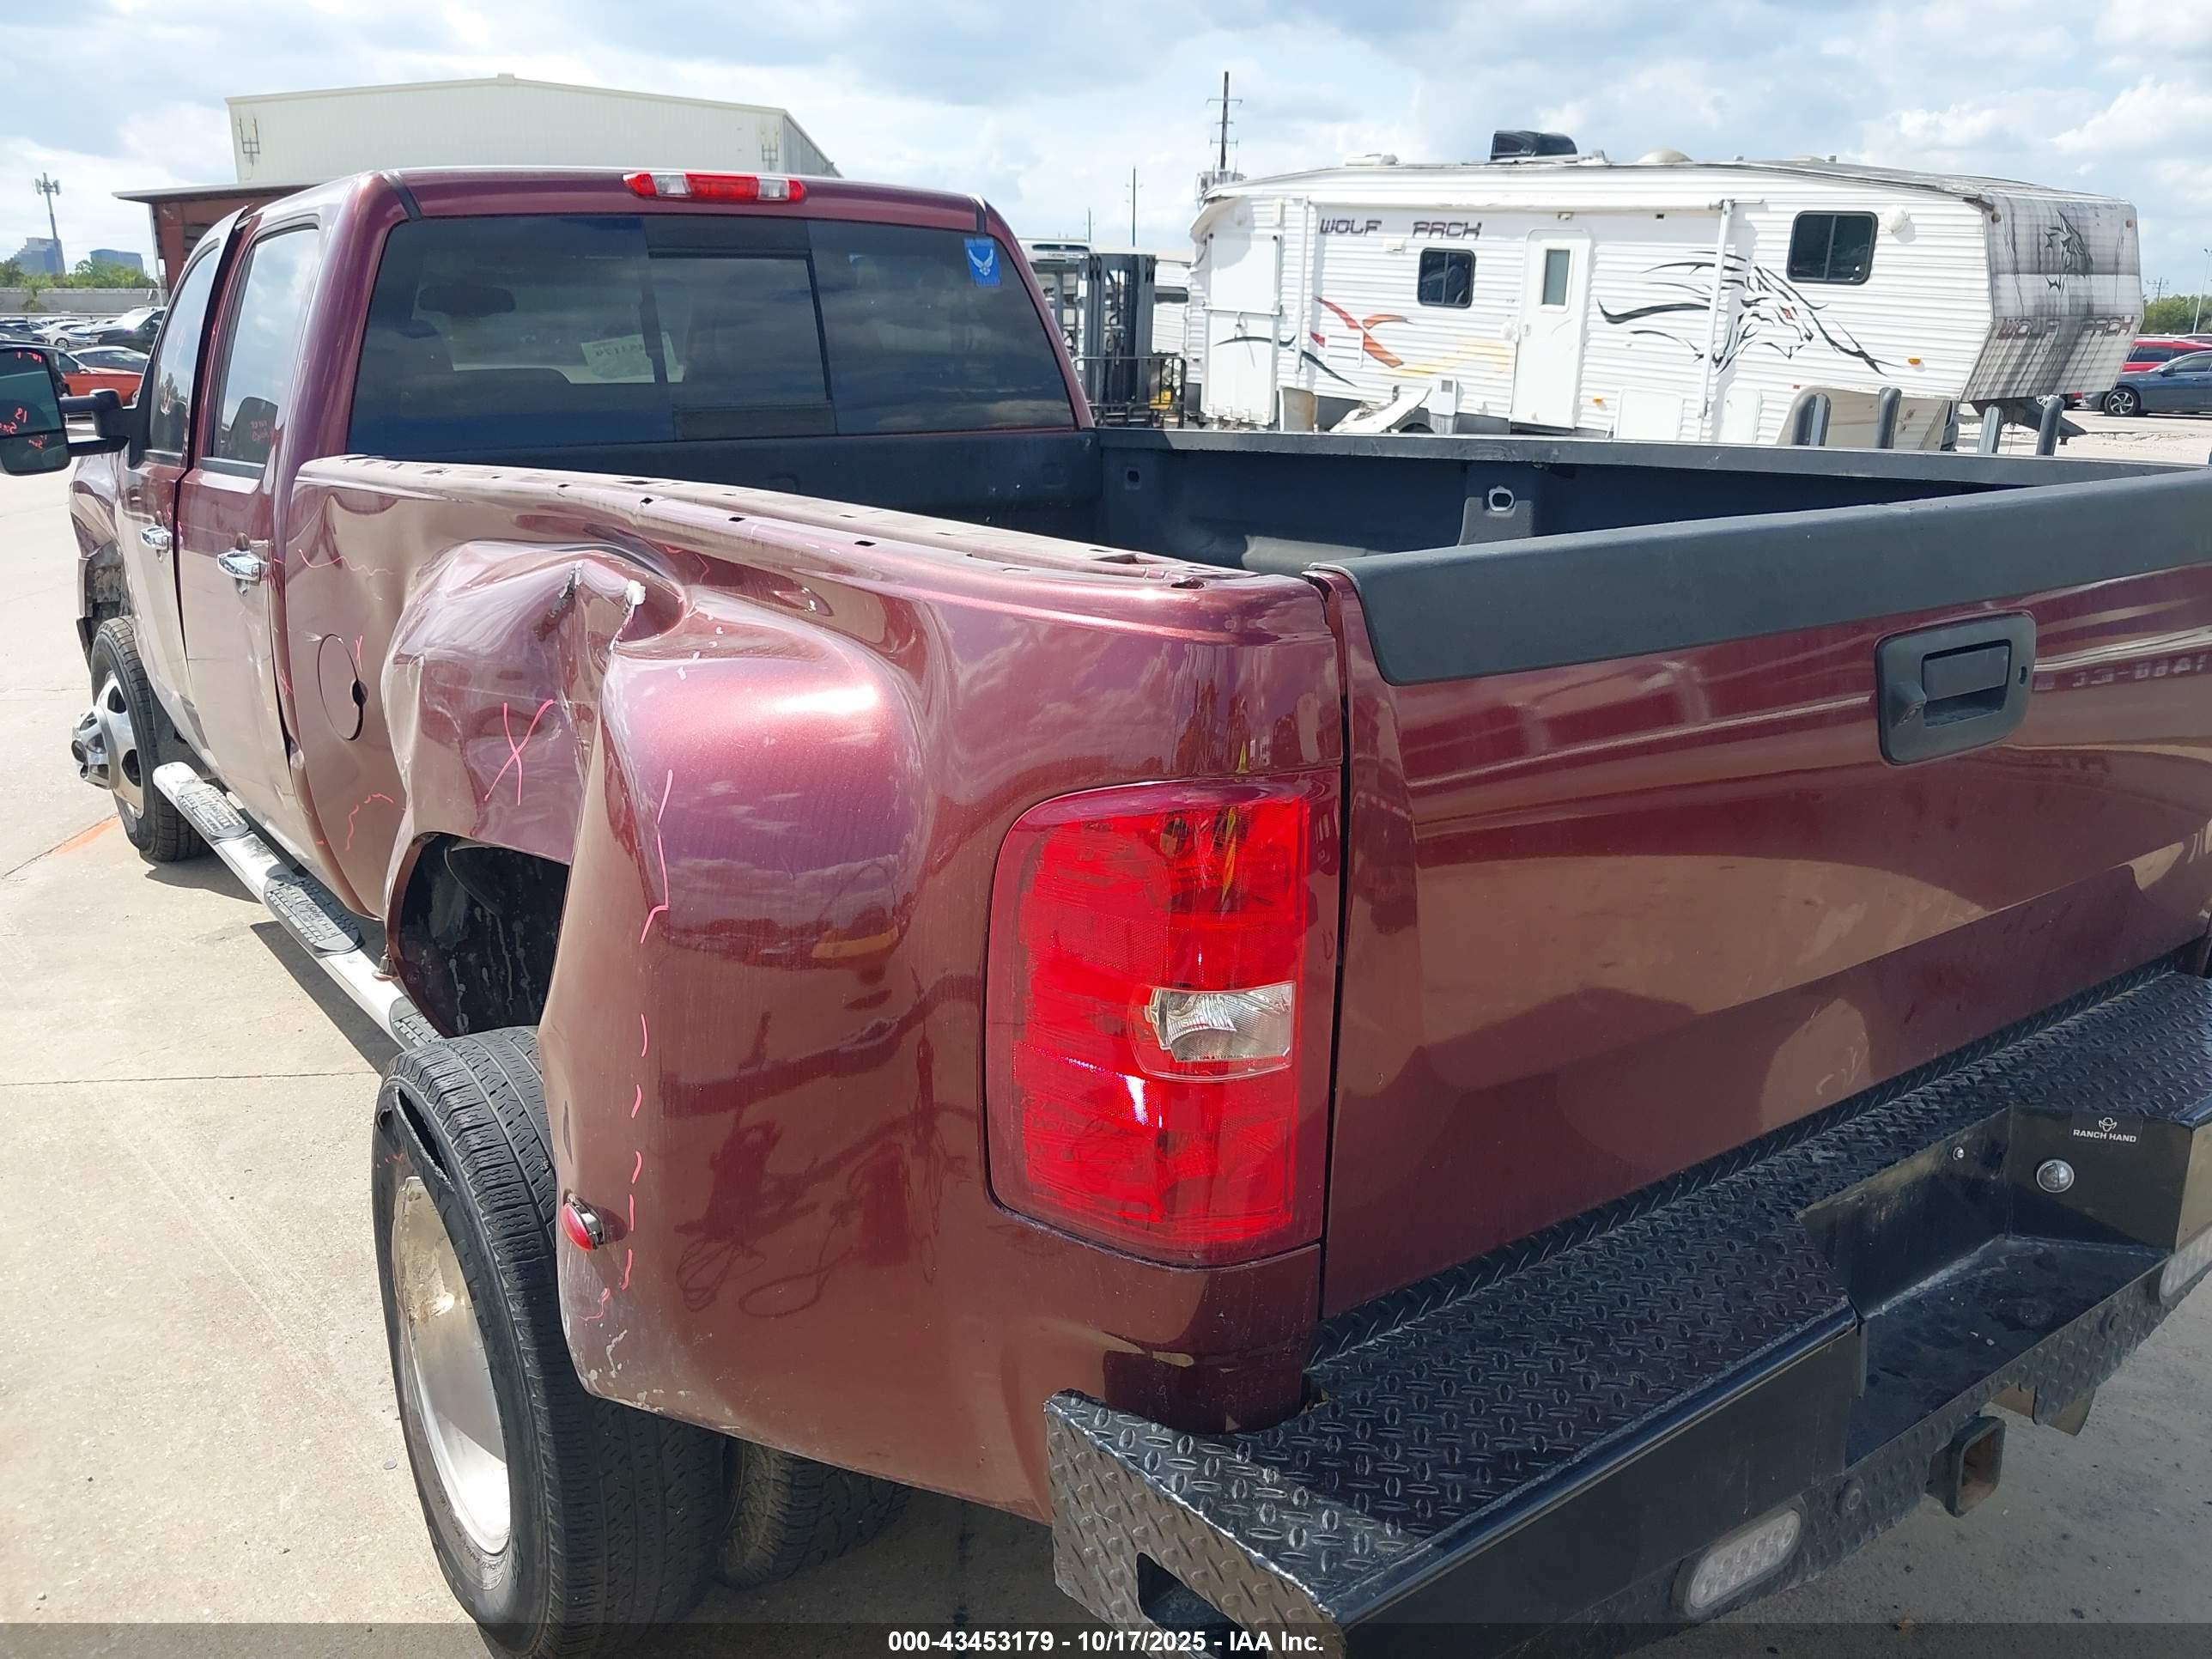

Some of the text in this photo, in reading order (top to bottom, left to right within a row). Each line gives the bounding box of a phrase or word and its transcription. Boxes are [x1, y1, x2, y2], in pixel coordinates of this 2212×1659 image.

[1319, 219, 1382, 236] WOLF
[2073, 1128, 2137, 1143] RANCH HAND
